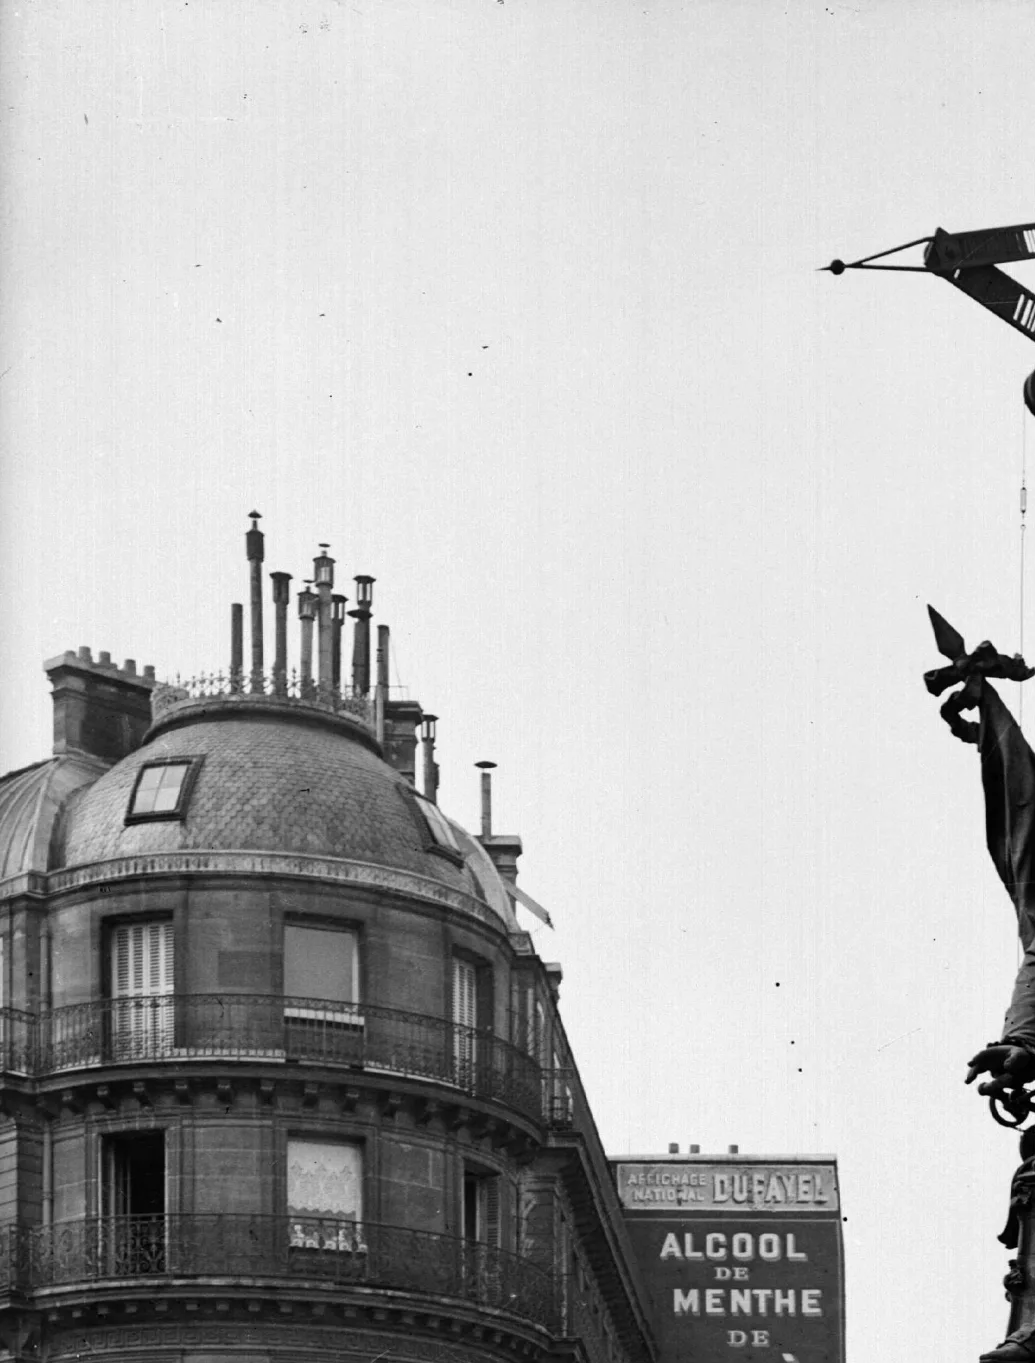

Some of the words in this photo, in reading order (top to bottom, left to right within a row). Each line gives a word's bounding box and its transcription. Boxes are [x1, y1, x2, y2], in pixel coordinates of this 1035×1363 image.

[627, 1173, 707, 1187] AFFICHAGE
[713, 1173, 829, 1204] DUFAYEL
[633, 1187, 706, 1203] NATIONAL
[660, 1232, 809, 1261] ALCOOL
[714, 1266, 749, 1281] DE
[673, 1288, 823, 1316] MENTHE
[727, 1330, 770, 1347] DE
